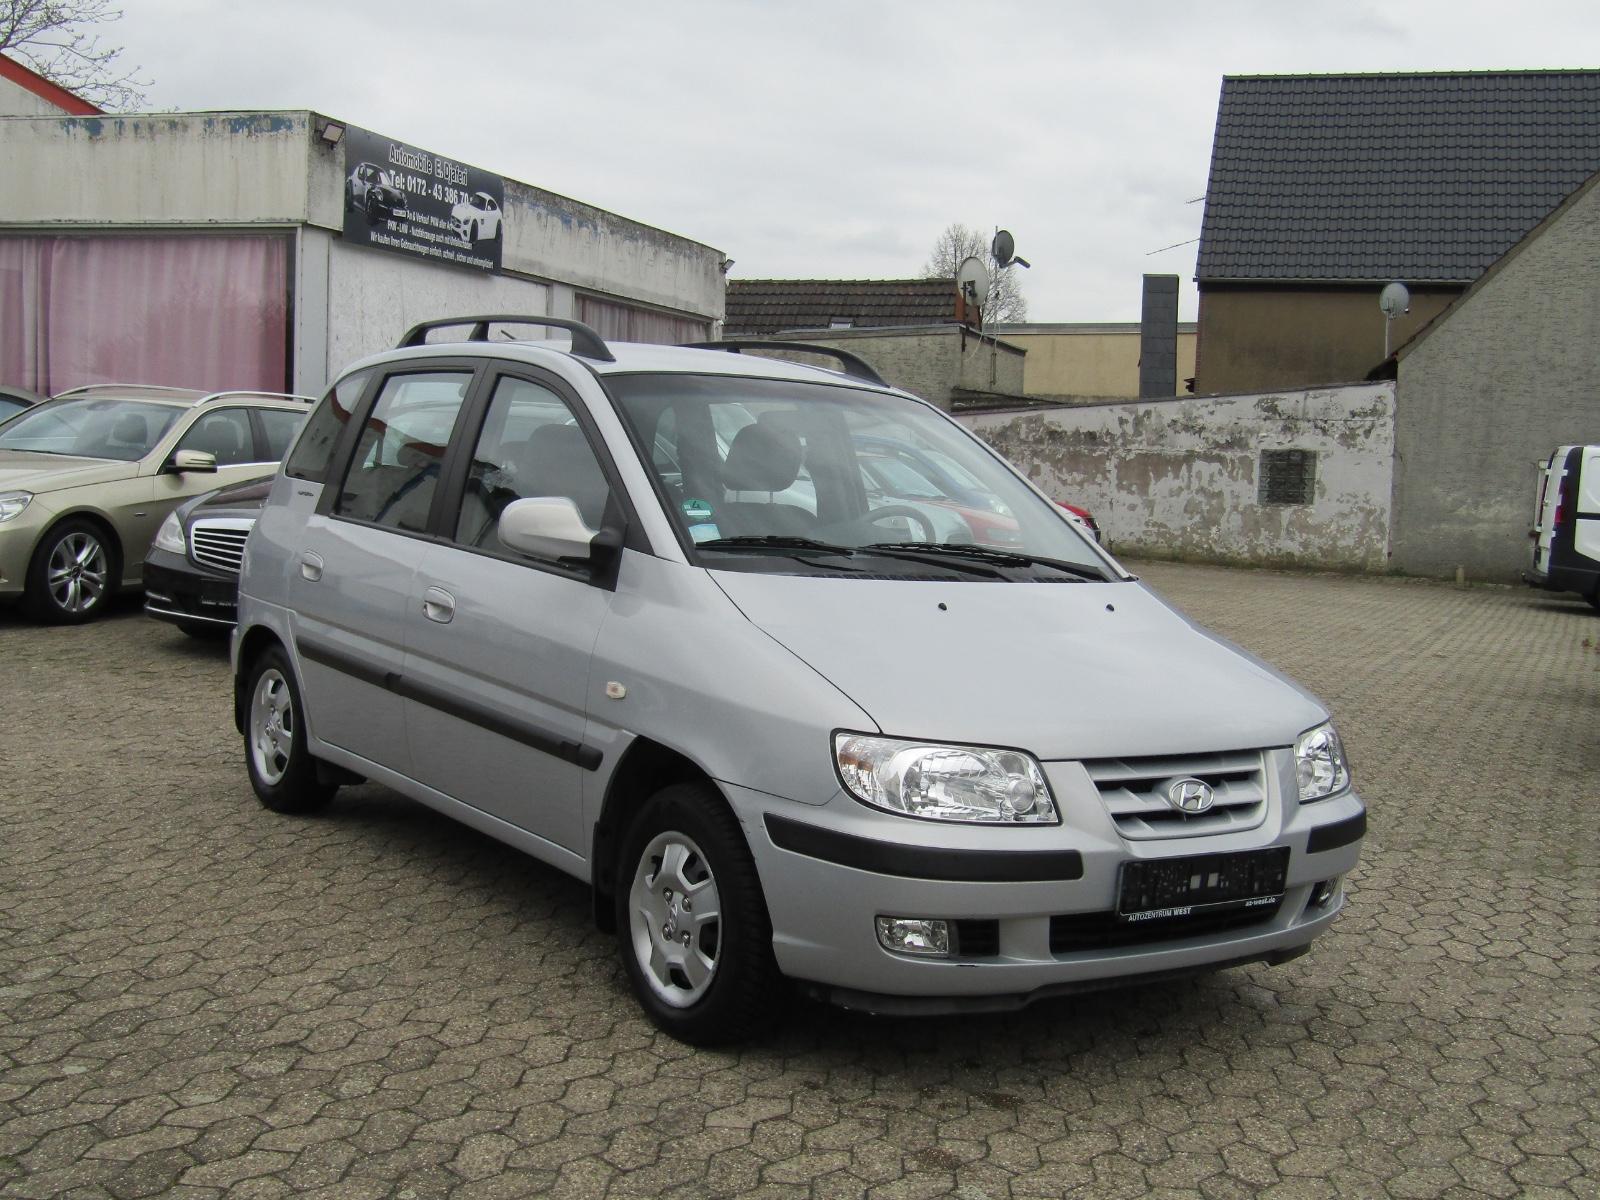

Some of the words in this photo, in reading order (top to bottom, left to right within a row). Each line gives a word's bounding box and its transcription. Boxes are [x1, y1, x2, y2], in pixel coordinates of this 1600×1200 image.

[389, 144, 432, 175] Automobile
[390, 170, 405, 190] Tel:
[408, 175, 426, 196] 0172
[433, 184, 442, 200] 43
[444, 187, 458, 205] 386
[1128, 910, 1172, 921] AUTOZENTRUM
[1174, 908, 1191, 916] WEST
